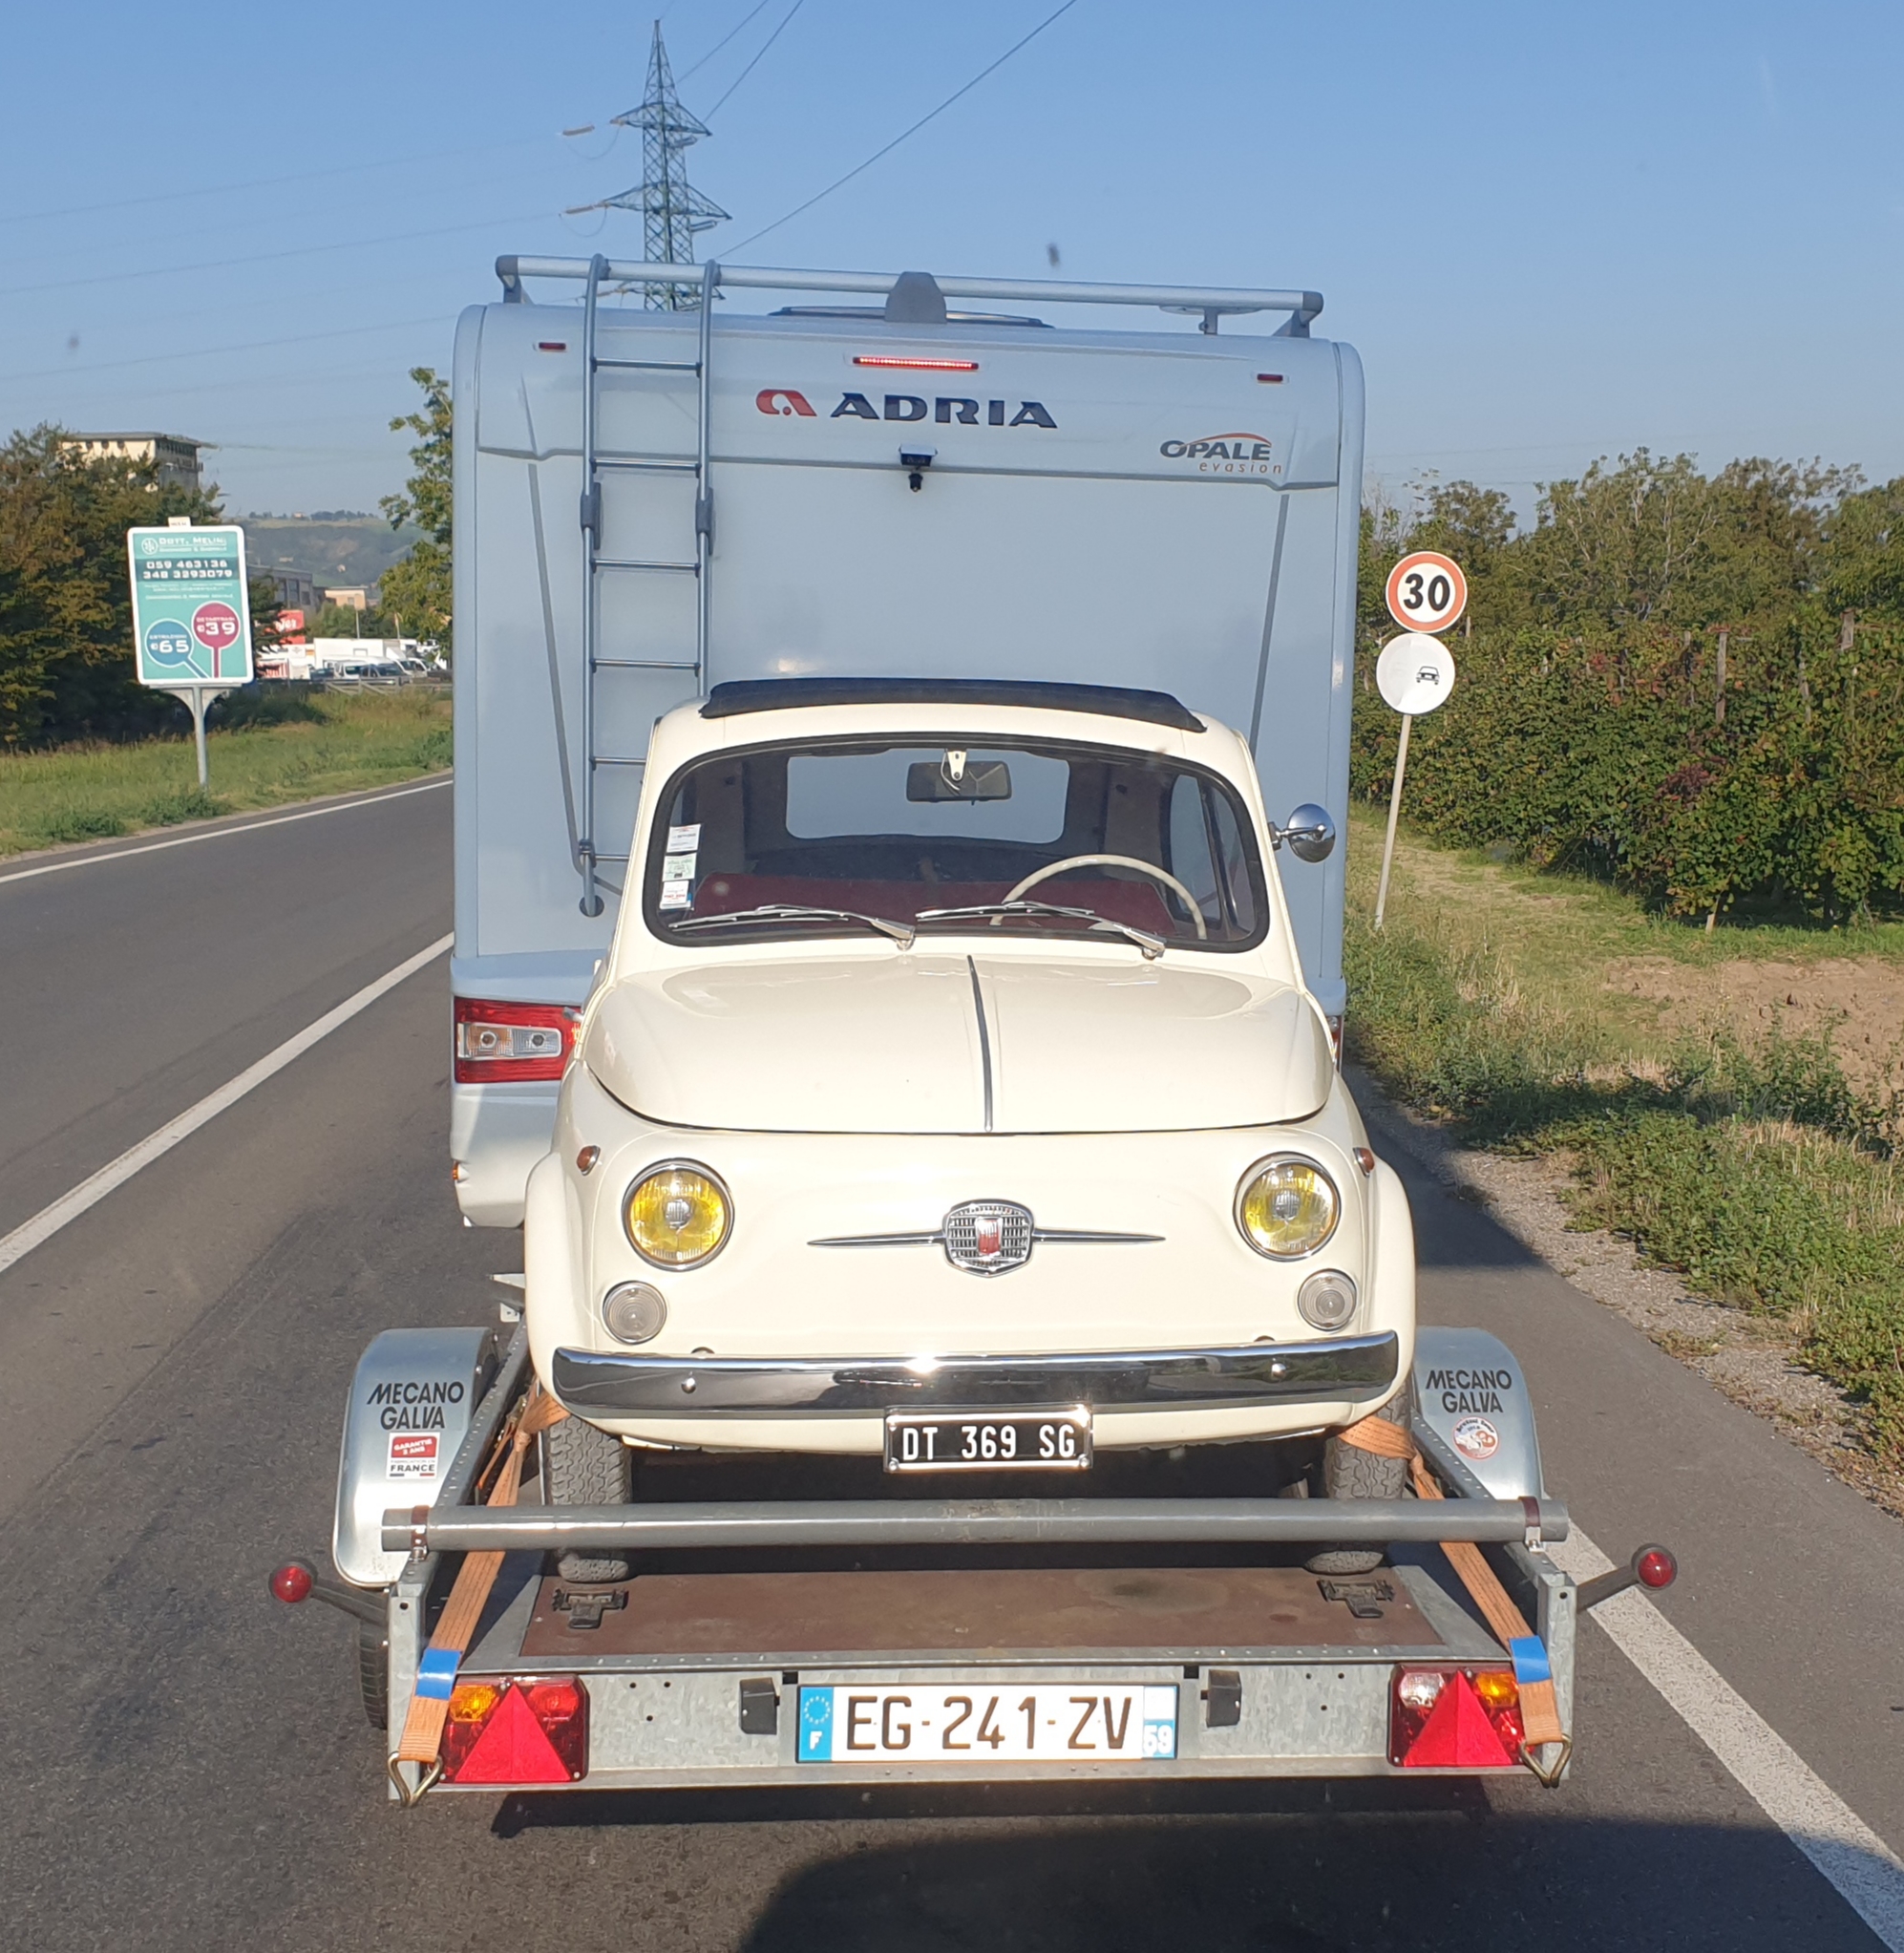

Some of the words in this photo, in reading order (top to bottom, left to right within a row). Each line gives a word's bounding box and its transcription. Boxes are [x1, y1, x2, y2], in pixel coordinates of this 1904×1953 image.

[830, 392, 1058, 429] ADRIA
[1159, 440, 1271, 461] OPALE
[1199, 461, 1282, 474] evasion
[143, 571, 168, 580] 348
[173, 569, 232, 579] 3293079
[146, 561, 172, 569] 059
[1403, 573, 1450, 612] 30
[1426, 1369, 1512, 1390] MECANO
[367, 1381, 464, 1405] MECANO
[1442, 1391, 1503, 1413] GALVA
[380, 1406, 445, 1430] GALVA
[902, 1427, 939, 1461] DT
[961, 1425, 1016, 1459] 369
[1039, 1423, 1075, 1458] SG
[846, 1695, 1132, 1751] EG-241-ZV
[809, 1730, 822, 1751] F
[1143, 1724, 1174, 1755] 59
